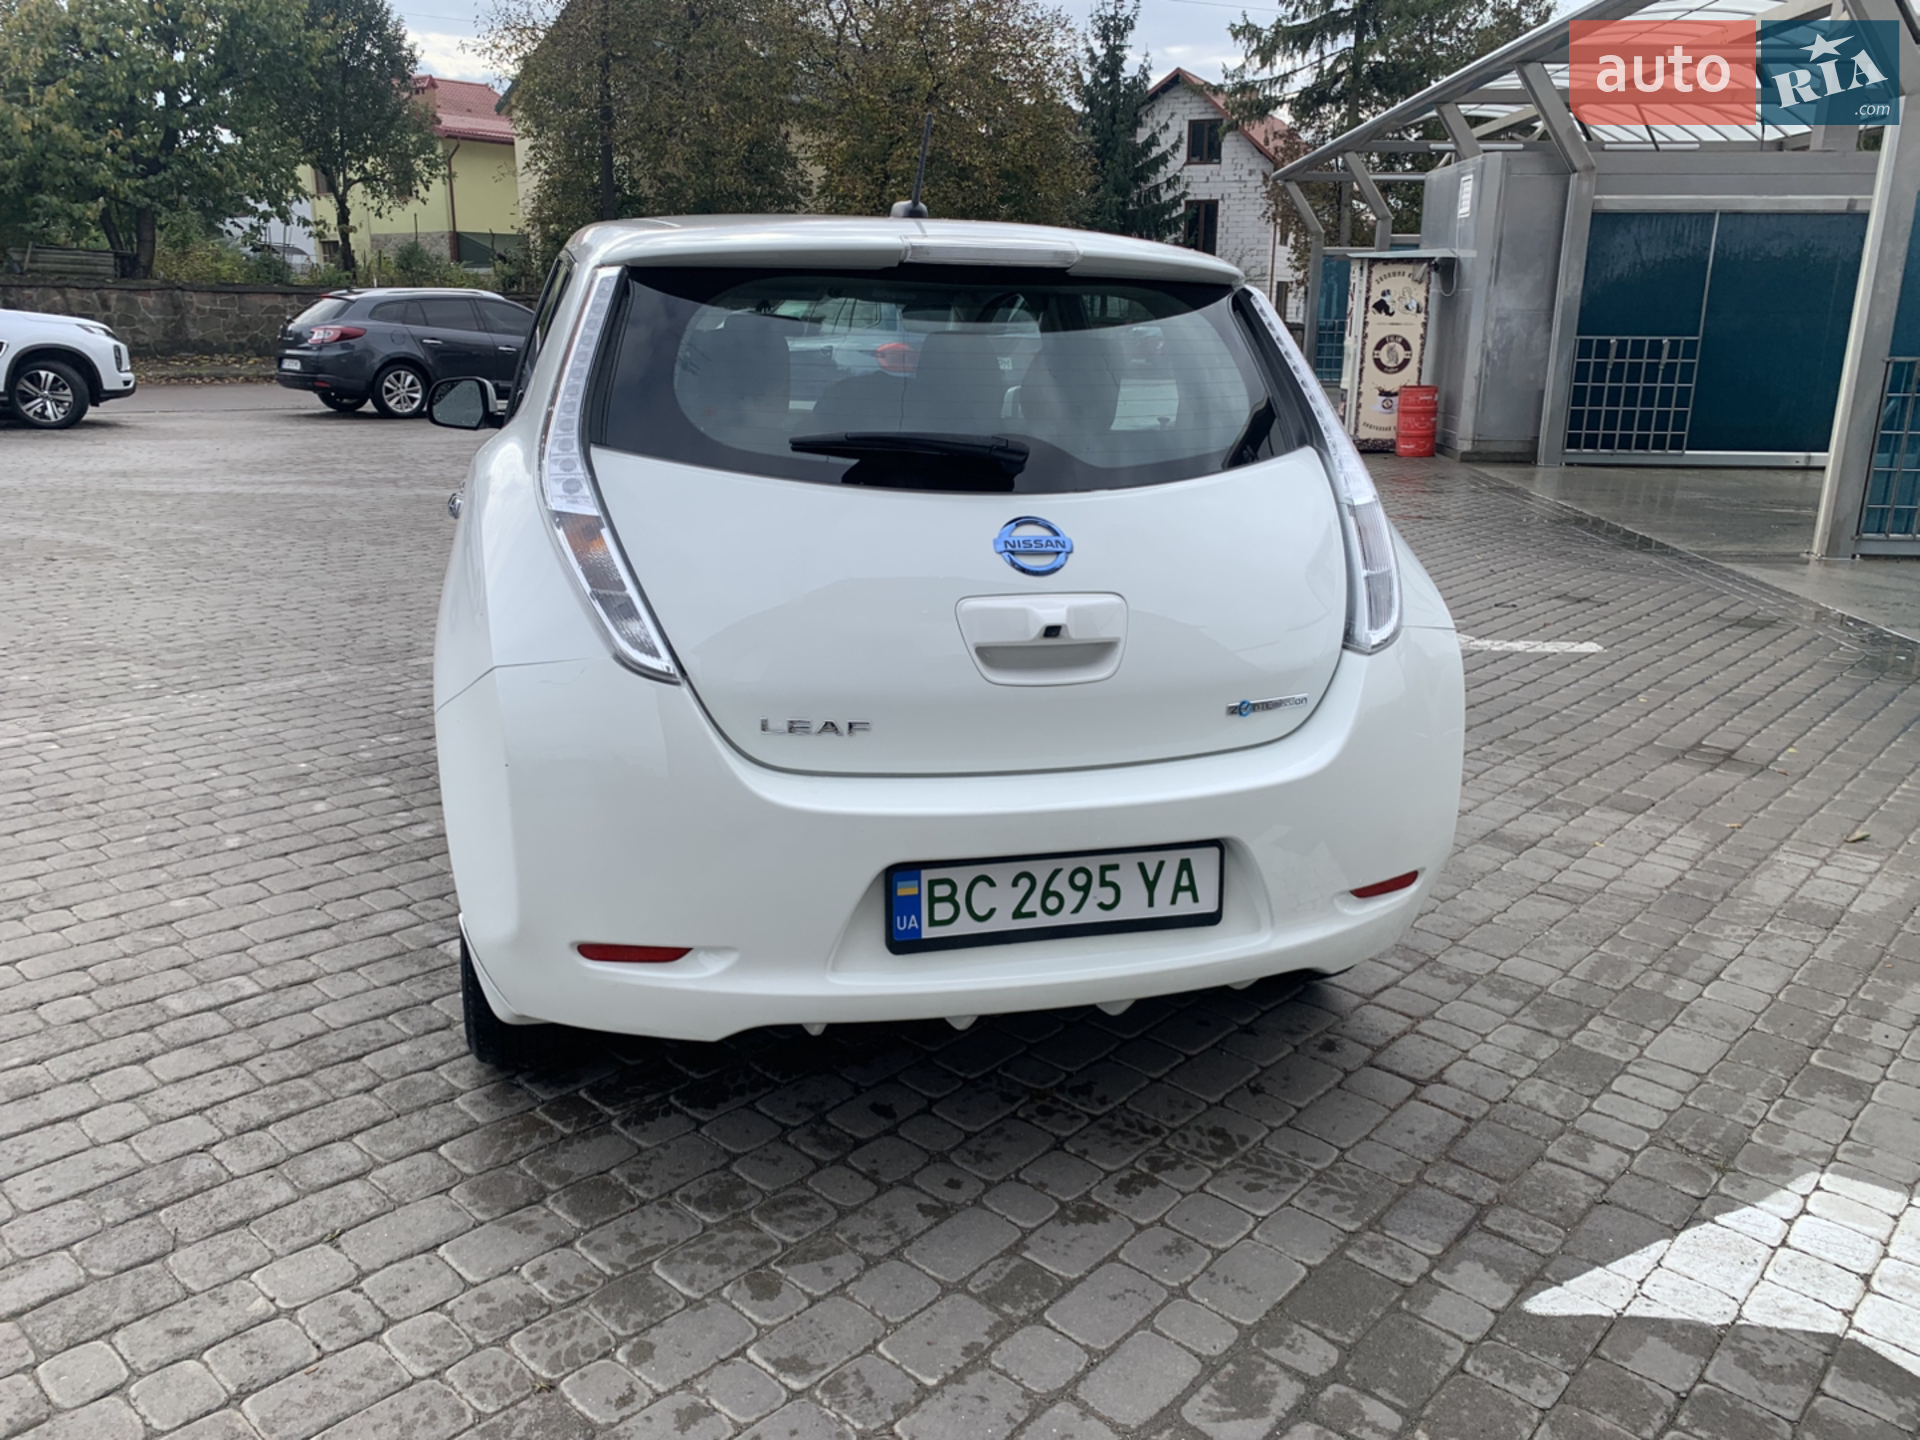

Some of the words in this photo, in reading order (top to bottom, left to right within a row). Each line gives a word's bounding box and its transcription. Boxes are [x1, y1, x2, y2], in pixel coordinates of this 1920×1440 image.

[1003, 539, 1067, 549] NISSAN
[760, 717, 872, 736] LEAF
[927, 874, 997, 928] BC
[1010, 862, 1121, 920] 2695
[1136, 857, 1200, 909] YA
[896, 914, 919, 931] UA
